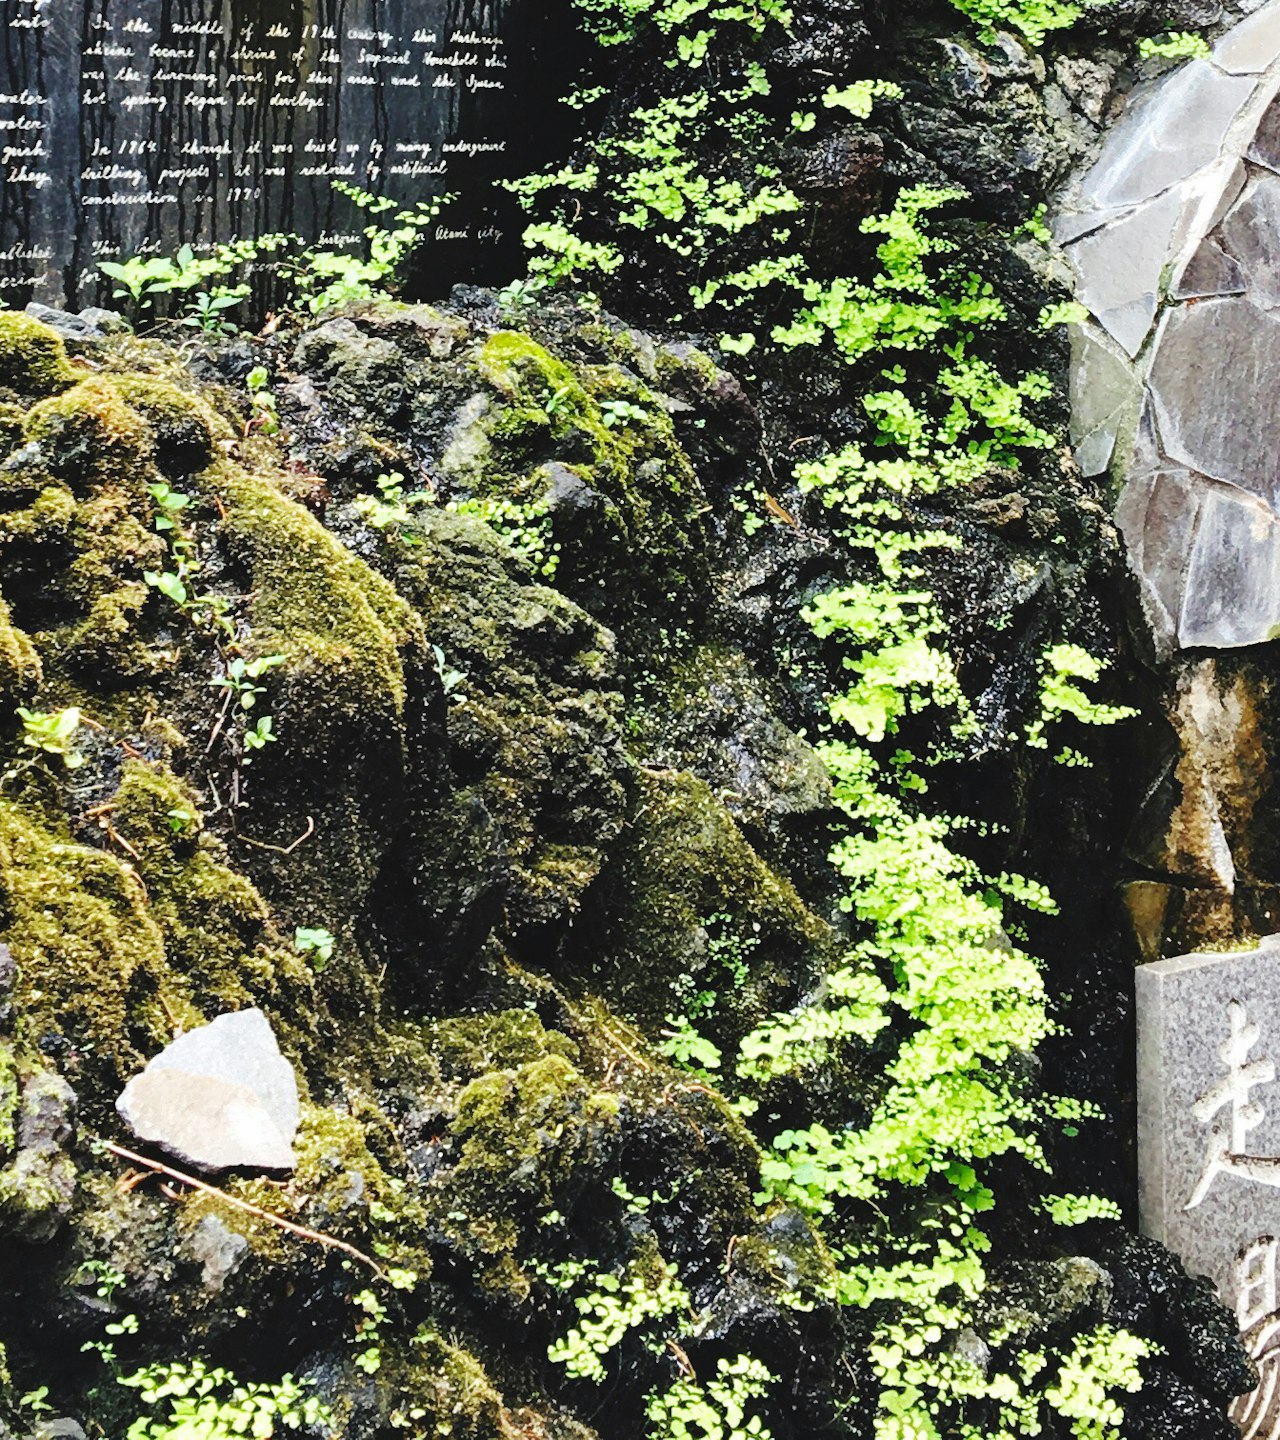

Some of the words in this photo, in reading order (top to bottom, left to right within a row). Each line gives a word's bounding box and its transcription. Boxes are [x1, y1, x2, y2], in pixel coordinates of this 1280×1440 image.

[91, 13, 114, 31] In
[122, 17, 153, 33] the
[171, 20, 224, 35] middle
[240, 22, 254, 41] of
[266, 24, 291, 38] the
[412, 29, 436, 43] this
[83, 42, 136, 57] shrine
[231, 46, 277, 60] shrine
[292, 46, 306, 67] of
[319, 49, 341, 63] the
[82, 70, 105, 80] was
[275, 70, 296, 87] for
[306, 71, 333, 84] this
[391, 76, 421, 87] and
[432, 76, 457, 88] the
[120, 92, 168, 111] spring
[184, 91, 228, 111] began
[237, 92, 256, 105] to
[91, 137, 111, 156] In
[180, 138, 233, 160] though
[246, 140, 262, 154] it
[346, 143, 360, 158] up
[370, 139, 383, 158] by
[81, 165, 143, 186] drilling
[235, 164, 251, 177] it
[264, 165, 286, 176] was
[299, 162, 355, 176] restored
[367, 161, 382, 181] by
[390, 160, 449, 179] artificial
[81, 191, 178, 206] construction
